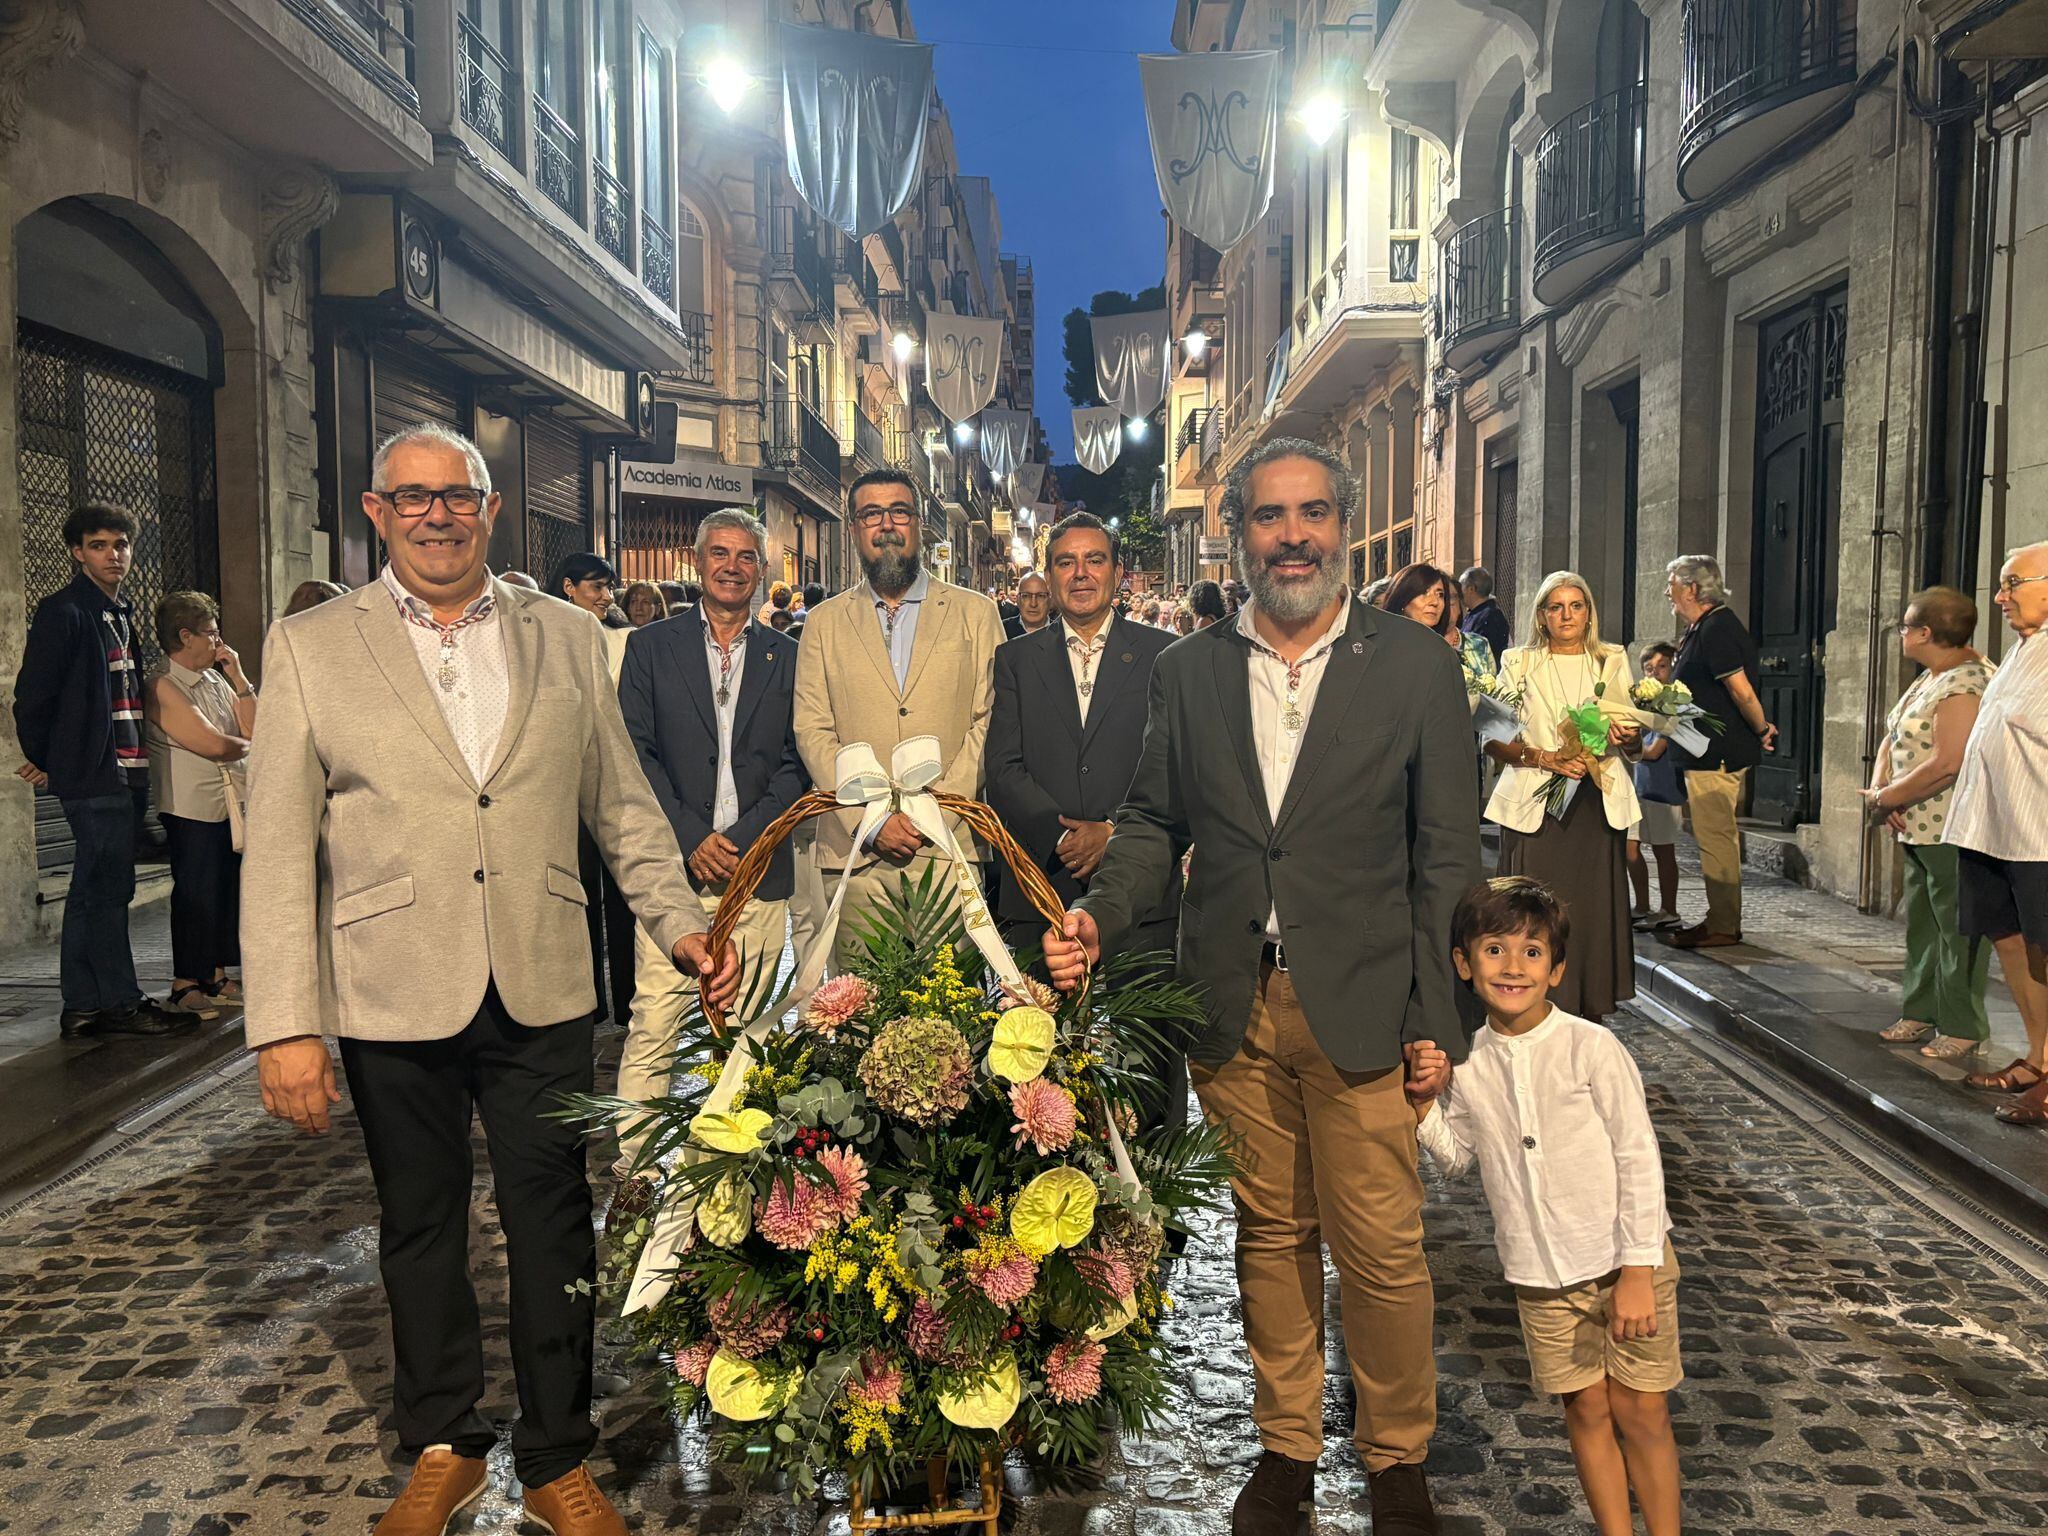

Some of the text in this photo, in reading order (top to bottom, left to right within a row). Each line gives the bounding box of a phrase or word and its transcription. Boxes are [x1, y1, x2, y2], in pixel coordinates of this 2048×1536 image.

[1764, 211, 1780, 237] 44
[410, 246, 428, 277] 45
[624, 465, 742, 492] Academia Atlas
